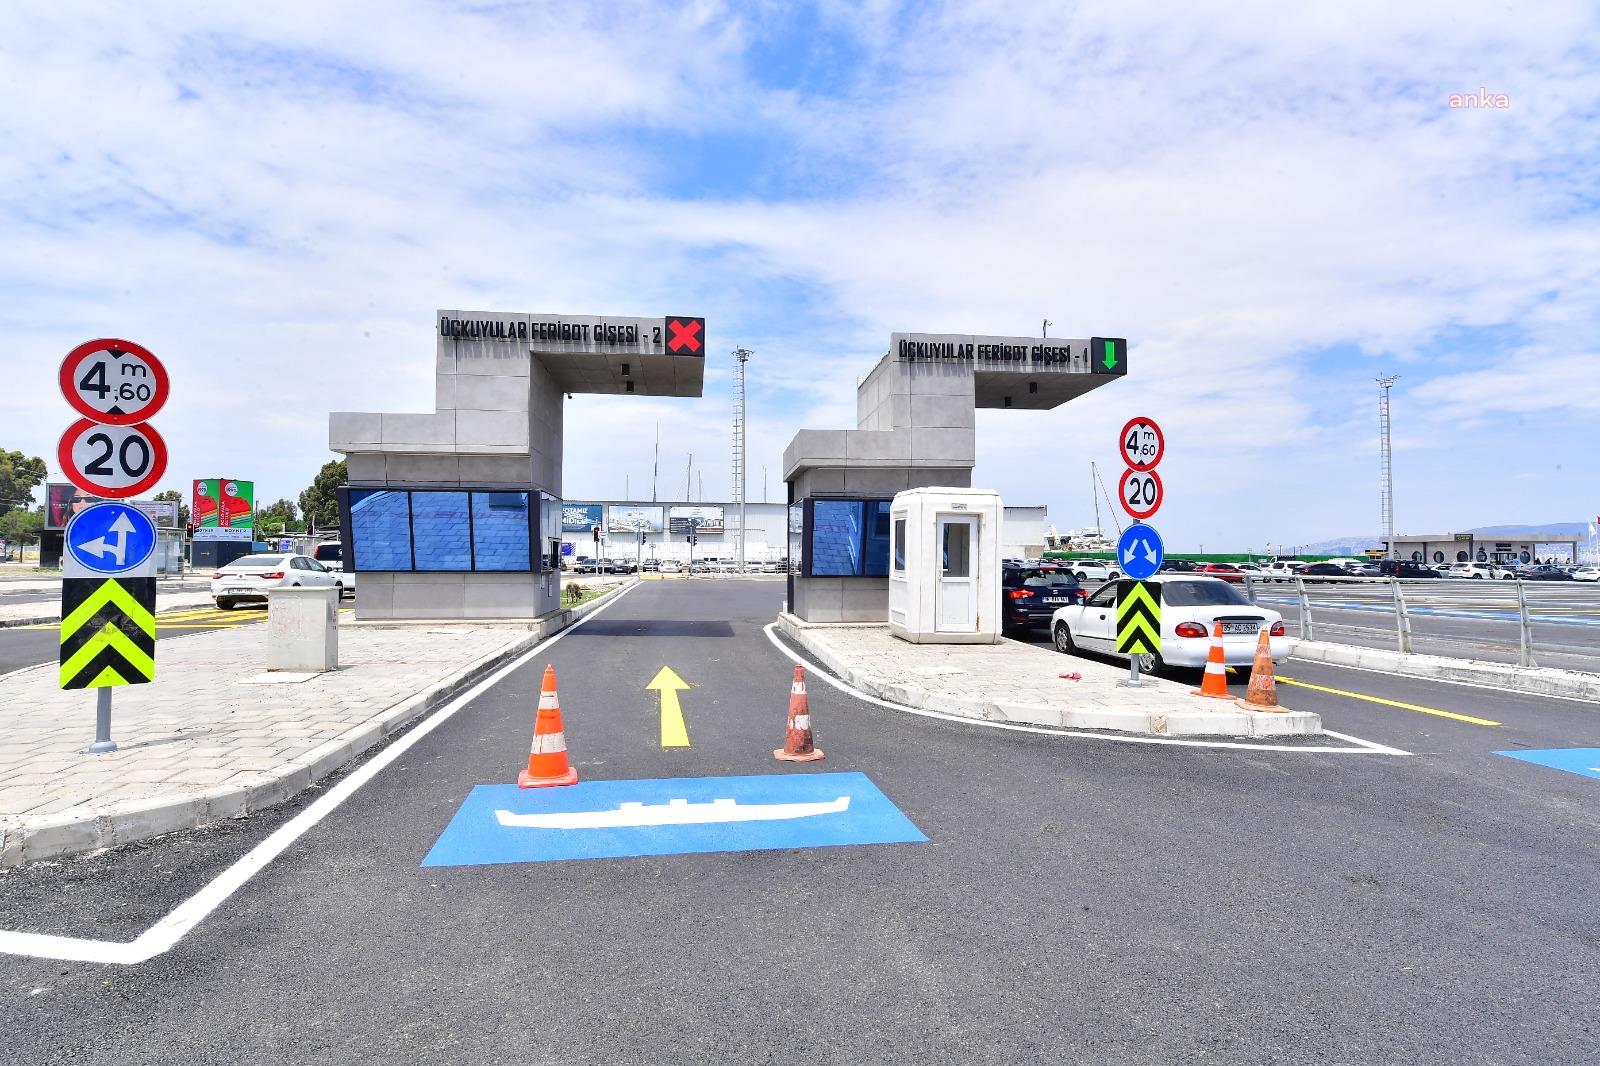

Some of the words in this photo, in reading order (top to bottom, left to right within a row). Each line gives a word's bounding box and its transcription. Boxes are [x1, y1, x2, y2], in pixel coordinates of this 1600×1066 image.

[531, 320, 590, 342] FERİBOT
[594, 323, 639, 345] GİŞESİ
[652, 326, 661, 343] 2
[898, 339, 974, 361] ÜÇKUYULAR
[977, 342, 1028, 362] FERİBOT
[1031, 344, 1071, 365] GİŞESİ
[121, 363, 147, 377] m
[1143, 430, 1155, 441] m
[84, 432, 150, 478] 20
[1128, 477, 1156, 505] 20
